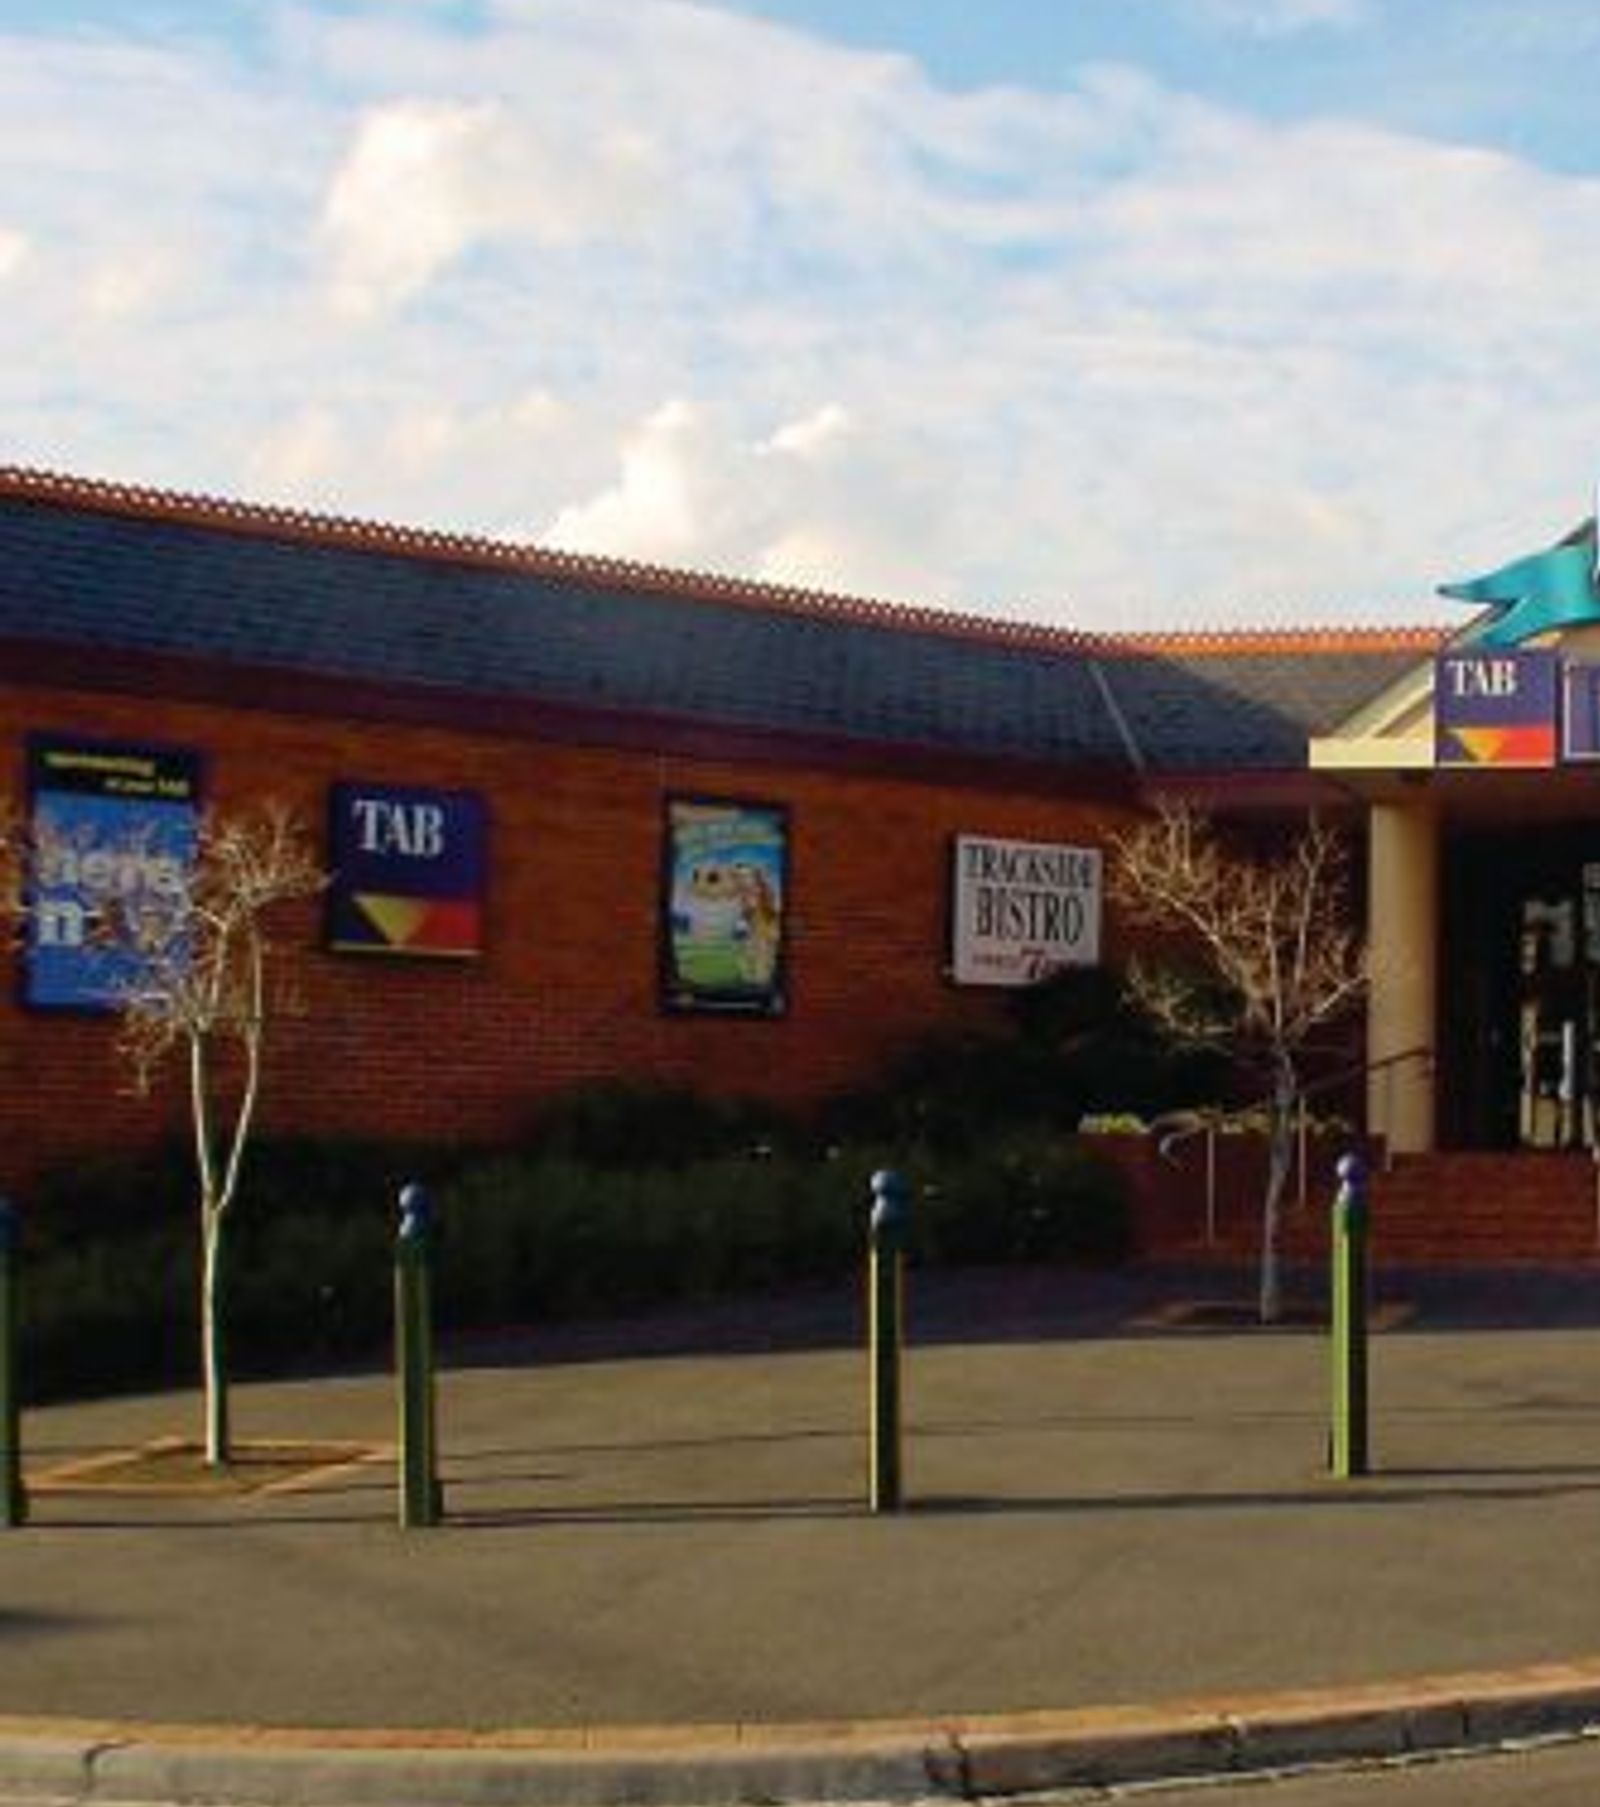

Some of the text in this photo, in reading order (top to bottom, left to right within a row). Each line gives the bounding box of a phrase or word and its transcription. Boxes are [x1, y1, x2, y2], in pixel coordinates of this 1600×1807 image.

[1447, 659, 1517, 696] TAB
[352, 798, 445, 857] TAB
[976, 886, 1084, 945] BISTRO
